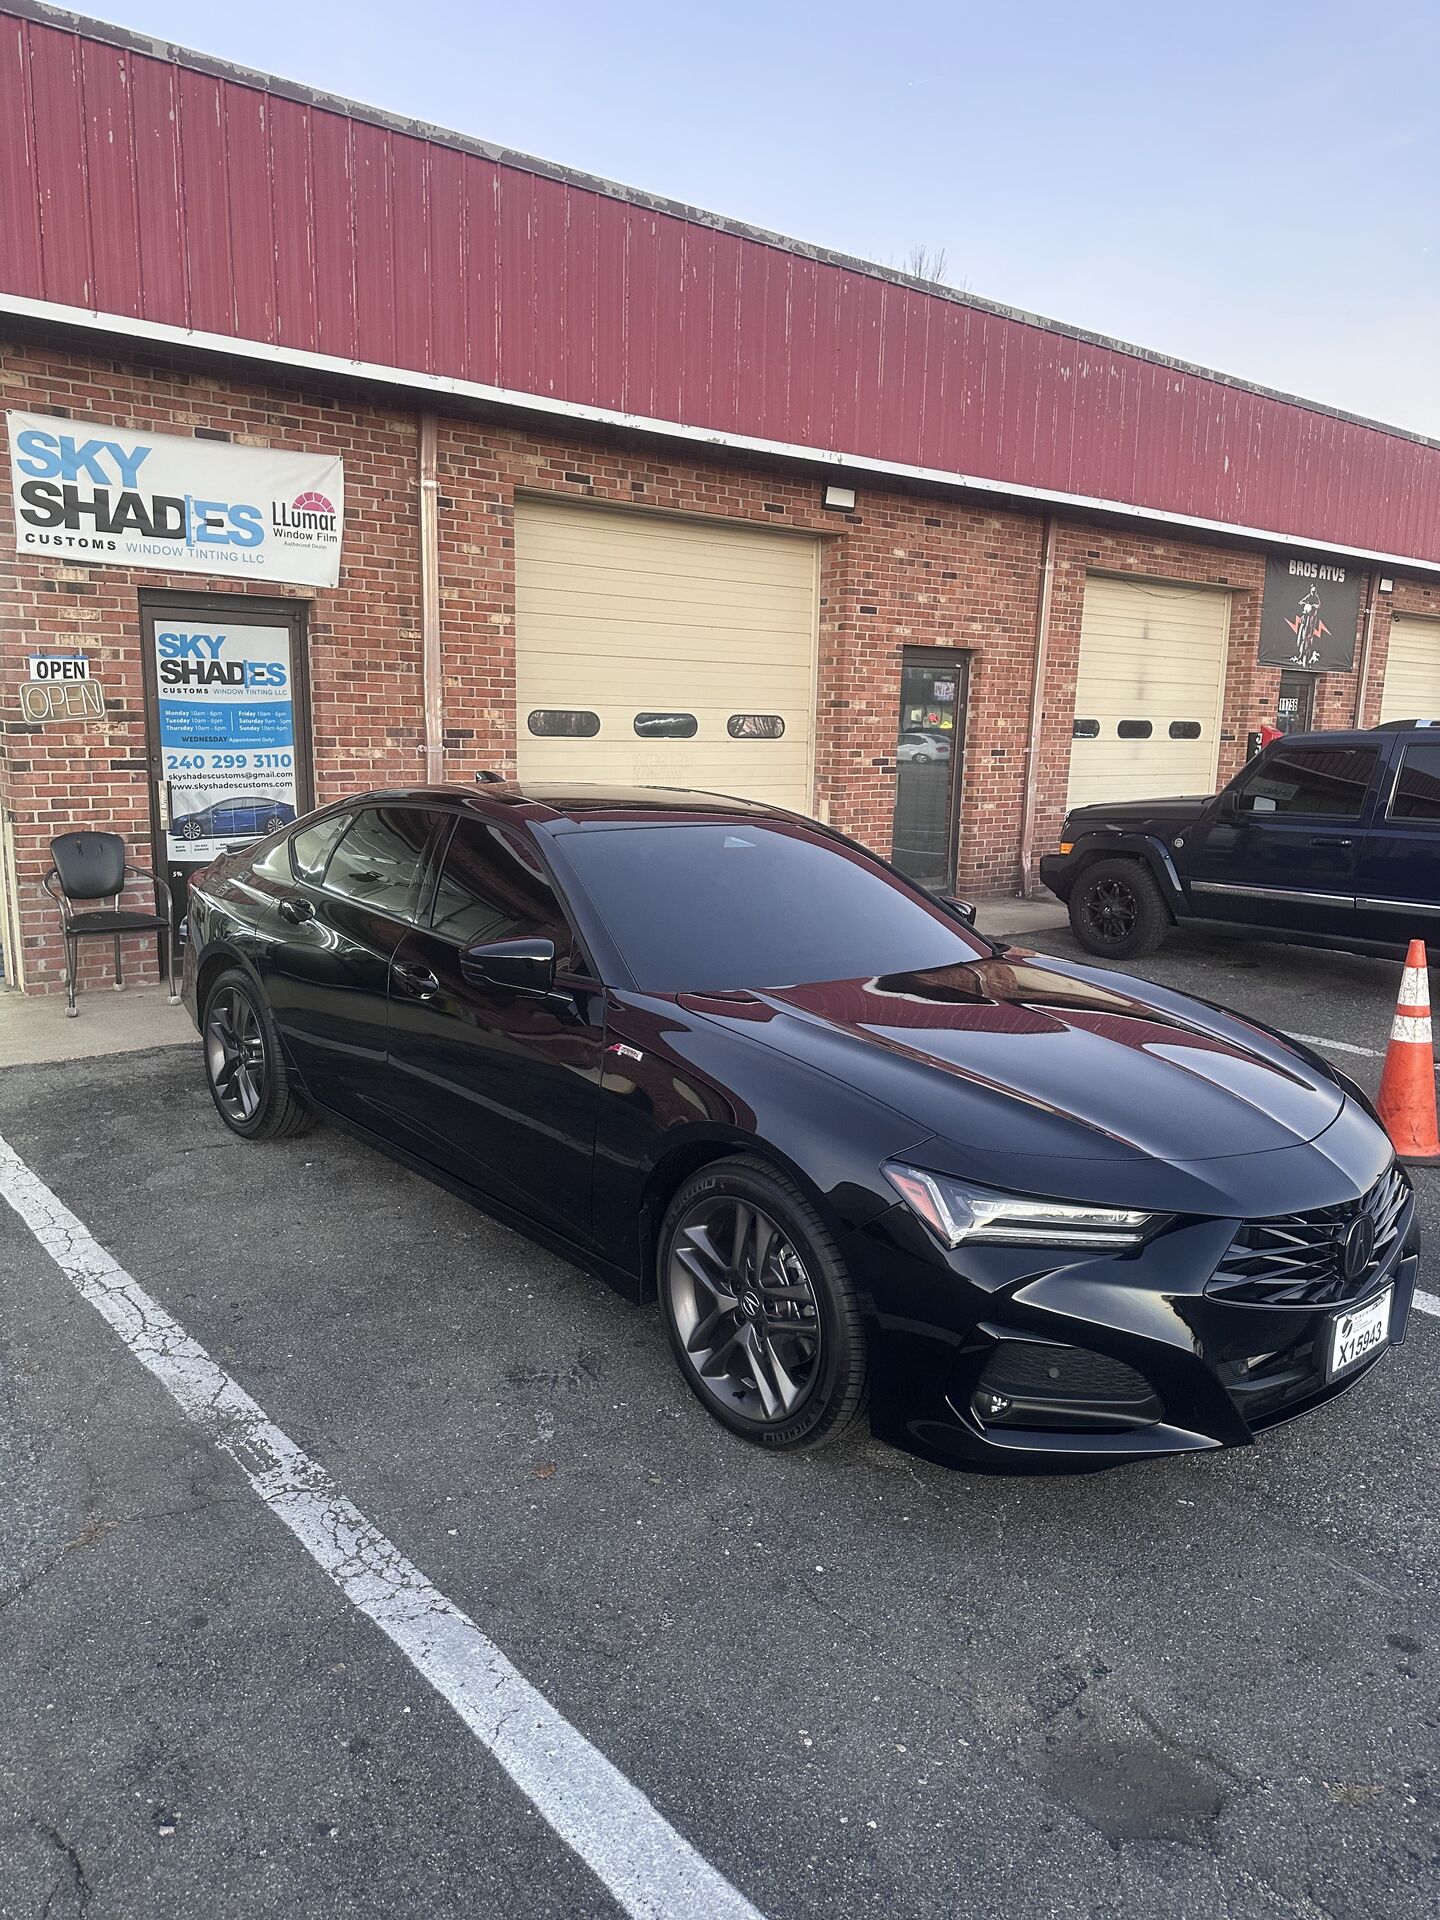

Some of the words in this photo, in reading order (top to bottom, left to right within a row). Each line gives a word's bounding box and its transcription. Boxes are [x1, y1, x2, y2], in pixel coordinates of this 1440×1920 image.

[16, 430, 152, 489] SKY
[20, 480, 265, 547] SHADES
[272, 501, 337, 532] LLumar
[273, 527, 313, 541] Window
[317, 532, 338, 543] Film
[25, 533, 117, 551] CUSTOMS
[125, 542, 184, 557] WINDOW
[187, 548, 238, 562] TINTING
[242, 553, 265, 565] LLC
[1289, 559, 1318, 579] BROS
[158, 633, 226, 659] SKY
[36, 661, 85, 679] OPEN
[160, 659, 287, 688] SHADES
[26, 683, 101, 719] OPEN
[163, 687, 209, 695] CUSTOMS
[213, 688, 244, 696] WINDOW
[165, 710, 190, 718] Monday
[239, 718, 264, 726] Saturday
[166, 725, 194, 733] Thursday
[239, 725, 260, 733] Sunday
[167, 755, 205, 769] 240
[211, 754, 247, 768] 299
[254, 754, 292, 768] 3110
[168, 771, 293, 781] skyshadescustoms@gmail.com
[1337, 1320, 1383, 1367] X15943
